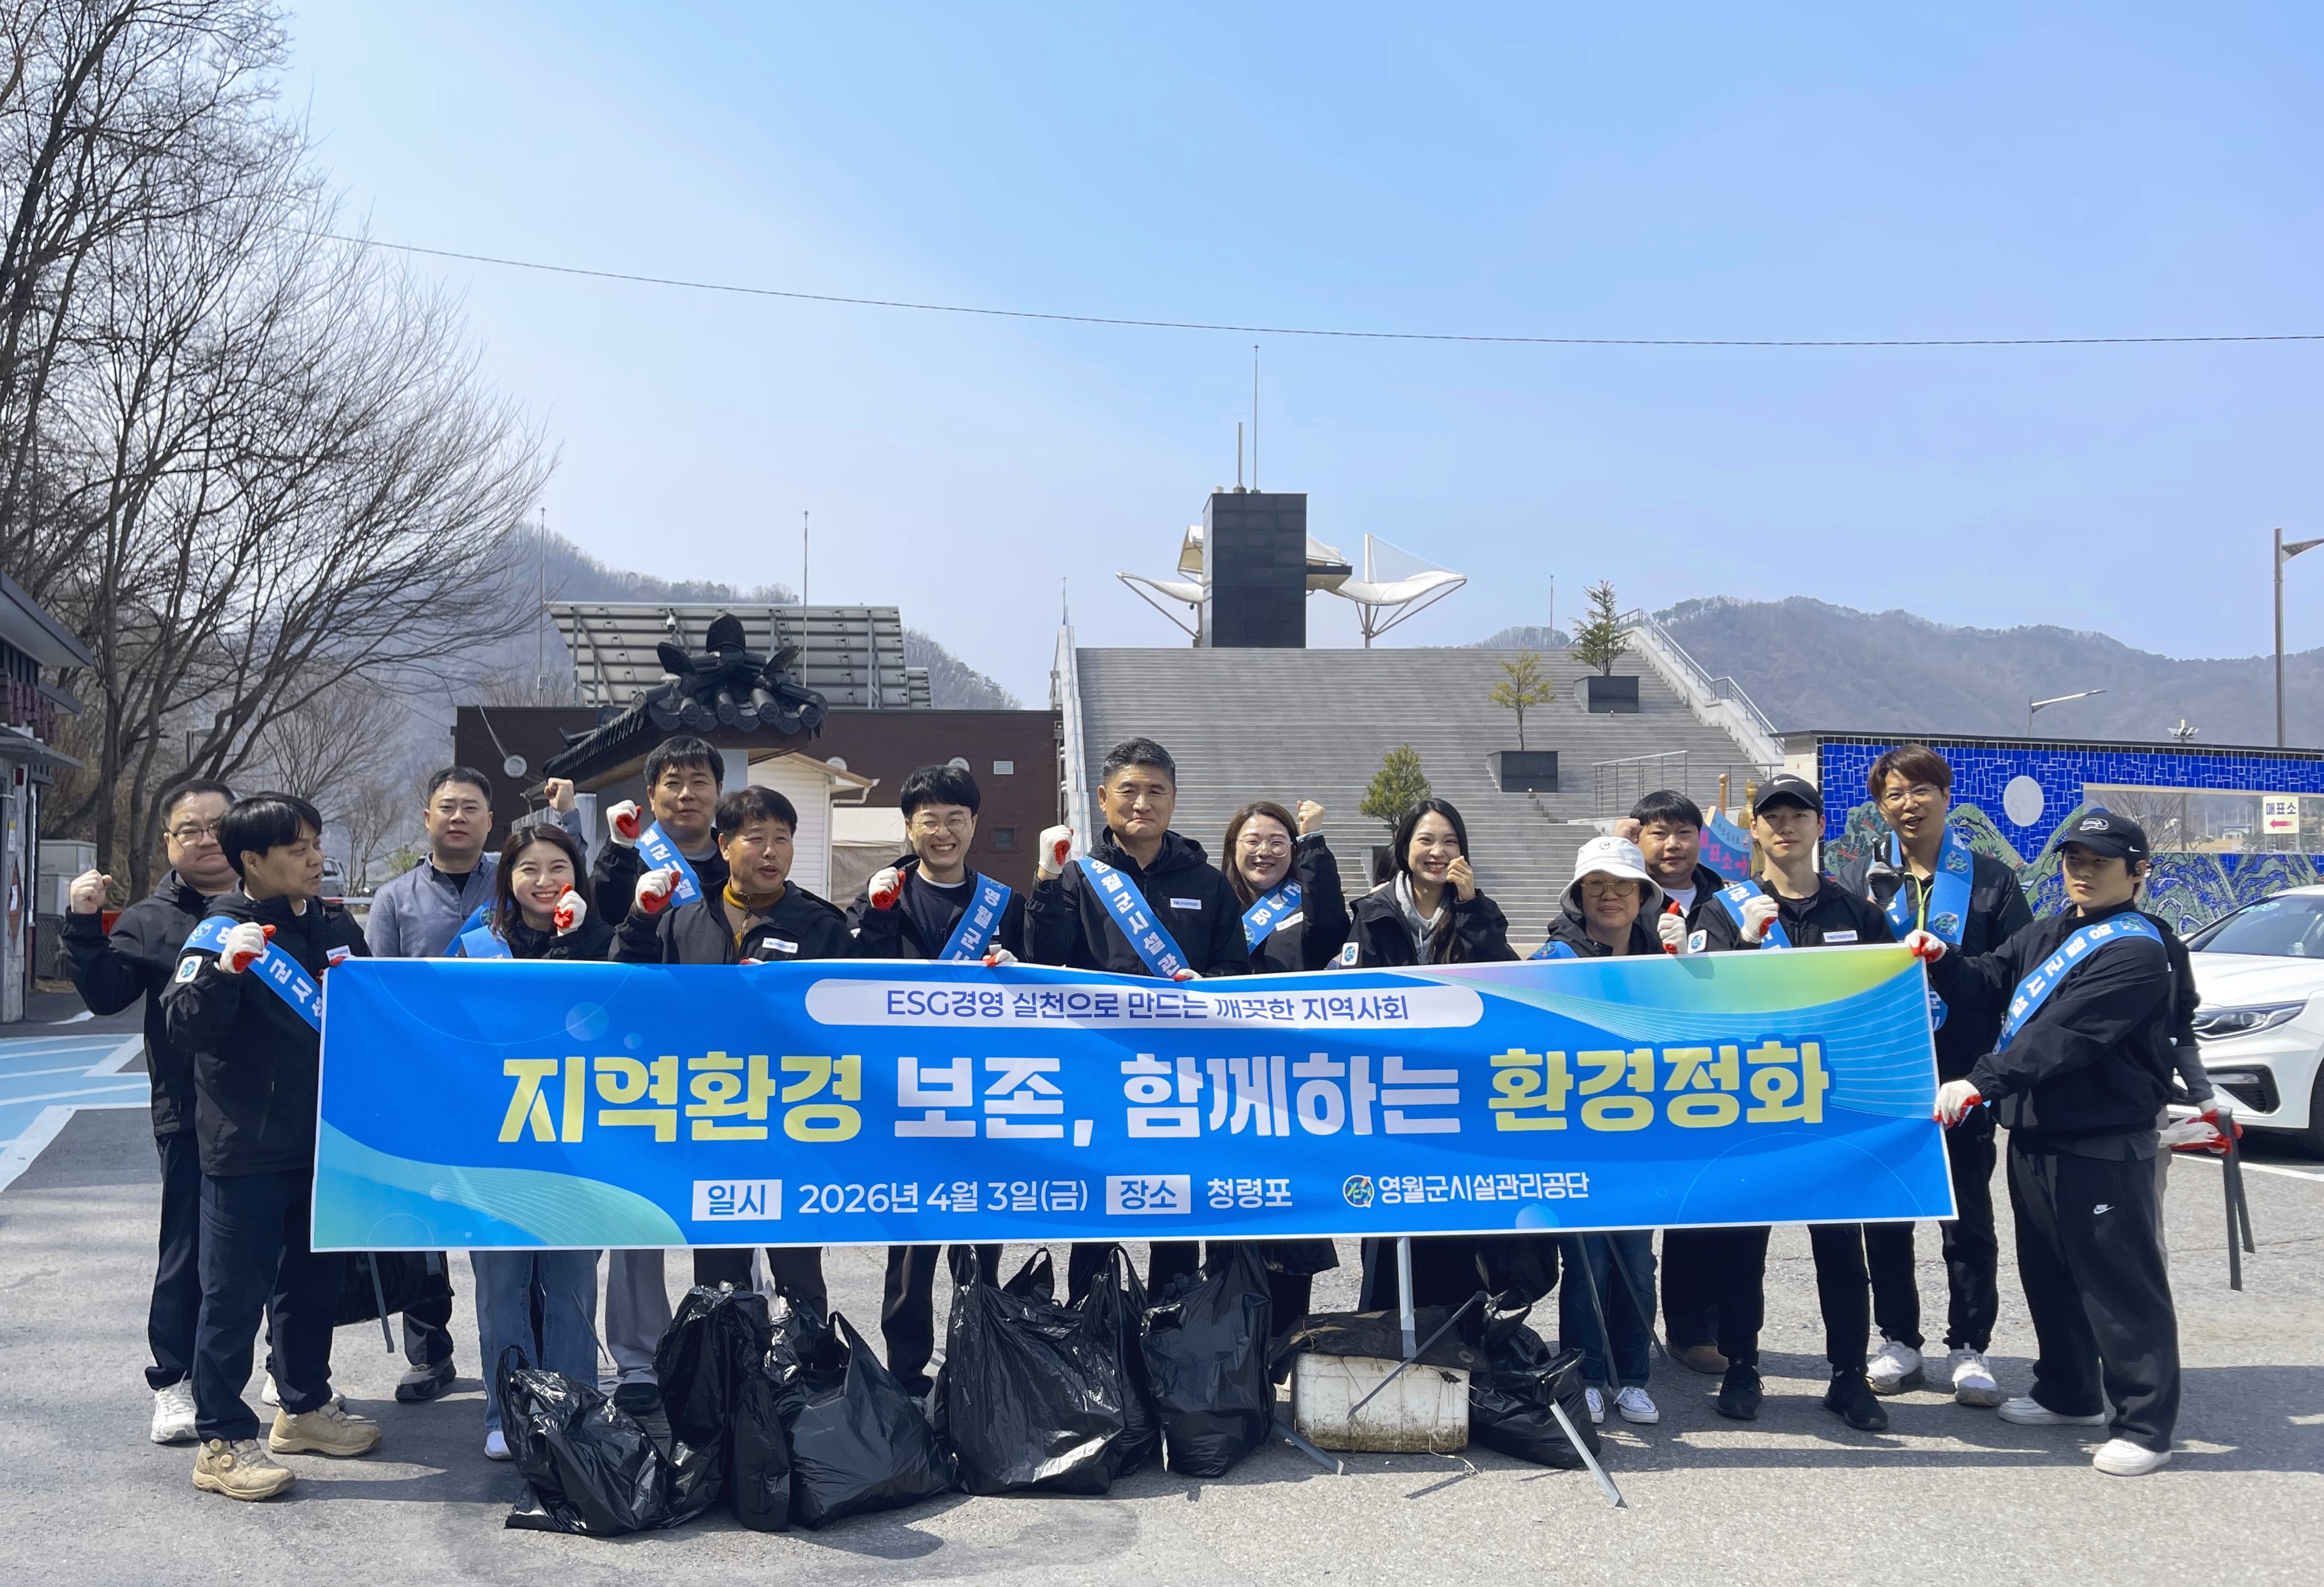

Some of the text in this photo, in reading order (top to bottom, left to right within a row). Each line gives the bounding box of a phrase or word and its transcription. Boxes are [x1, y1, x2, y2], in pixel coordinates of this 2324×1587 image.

[2266, 802, 2296, 815] 매표소
[887, 990, 1409, 1022] ESG경영 실천으로 만드는 깨끗한 지역사회
[498, 1040, 1829, 1147] 지역환경 보존, 함께하는 환경정화
[708, 1178, 1293, 1216] 일시 2026년 4월 3일(금) 장소 청령포
[1378, 1172, 1590, 1204] 영월군시설관리공단
